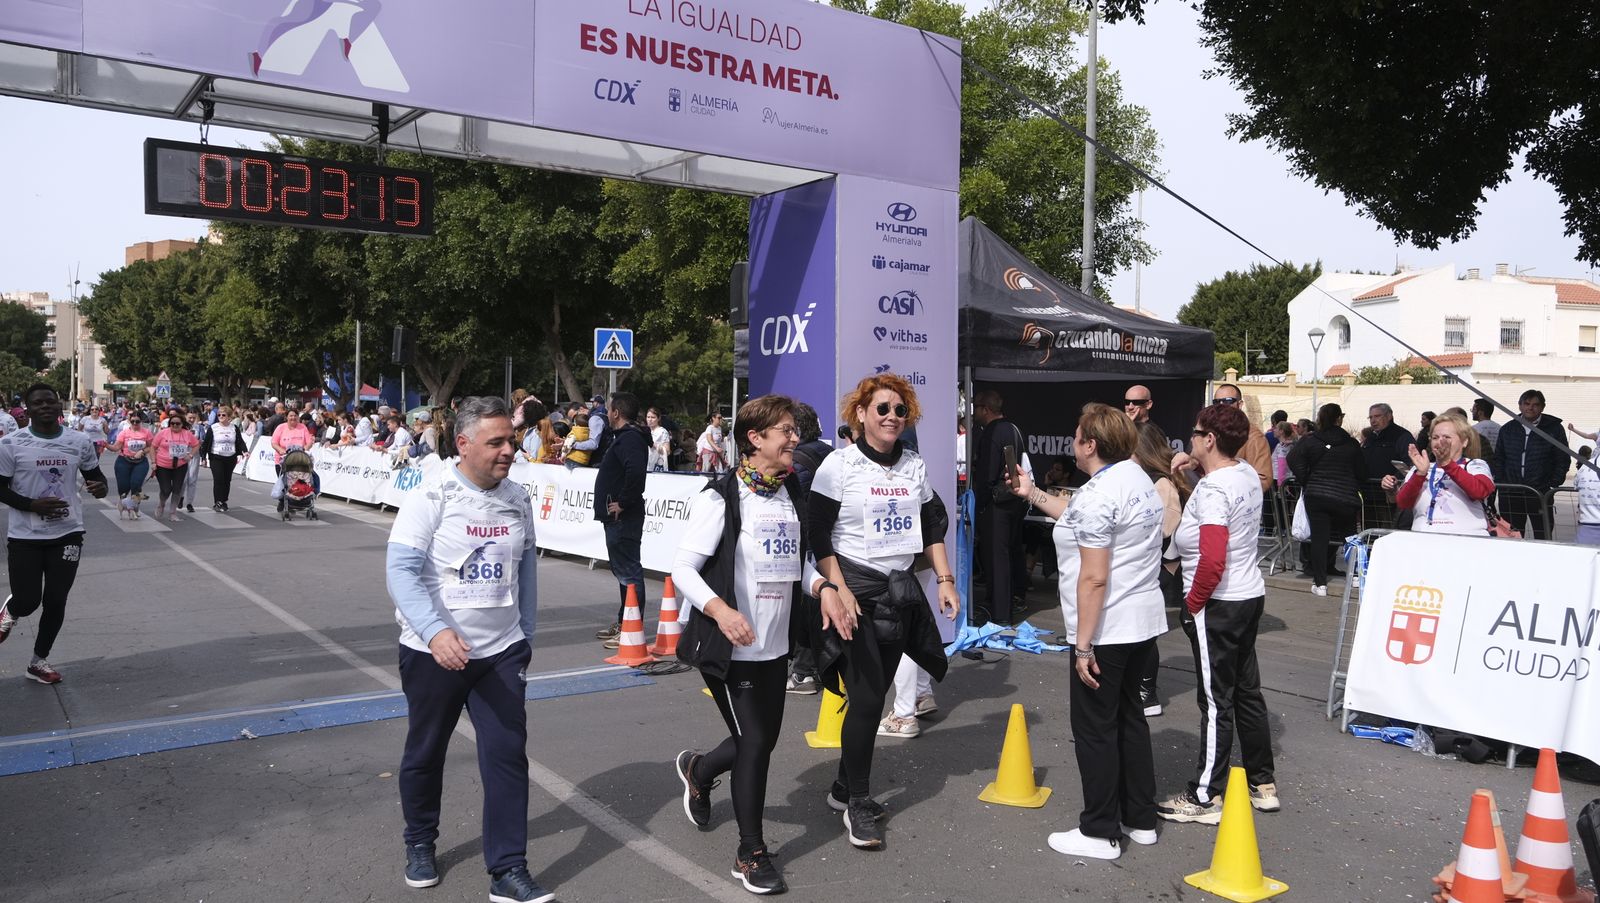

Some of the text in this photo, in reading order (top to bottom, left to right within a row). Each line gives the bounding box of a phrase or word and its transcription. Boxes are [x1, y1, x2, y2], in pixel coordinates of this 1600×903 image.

[628, 0, 802, 51] LA IGUALDAD
[580, 23, 839, 101] ES NUESTRA META.
[594, 78, 640, 105] CDX
[690, 93, 739, 113] ALMERÍA
[690, 105, 716, 117] CIUDAD
[199, 153, 421, 227] 00:23:13
[876, 222, 928, 237] HYUNDAI
[883, 234, 922, 247] Almerialva
[889, 259, 931, 273] cajamar
[878, 295, 915, 316] CASI
[760, 303, 816, 356] CDX
[890, 329, 928, 344] vithas
[1028, 434, 1075, 456] cruza
[36, 459, 68, 467] MUJER
[562, 488, 595, 510] ALME
[870, 487, 910, 497] MUJER
[466, 525, 510, 538] MUJER
[873, 515, 913, 533] 1366
[762, 538, 798, 555] 1365
[1487, 600, 1600, 651] ALM
[1483, 646, 1590, 682] CIUDAD
